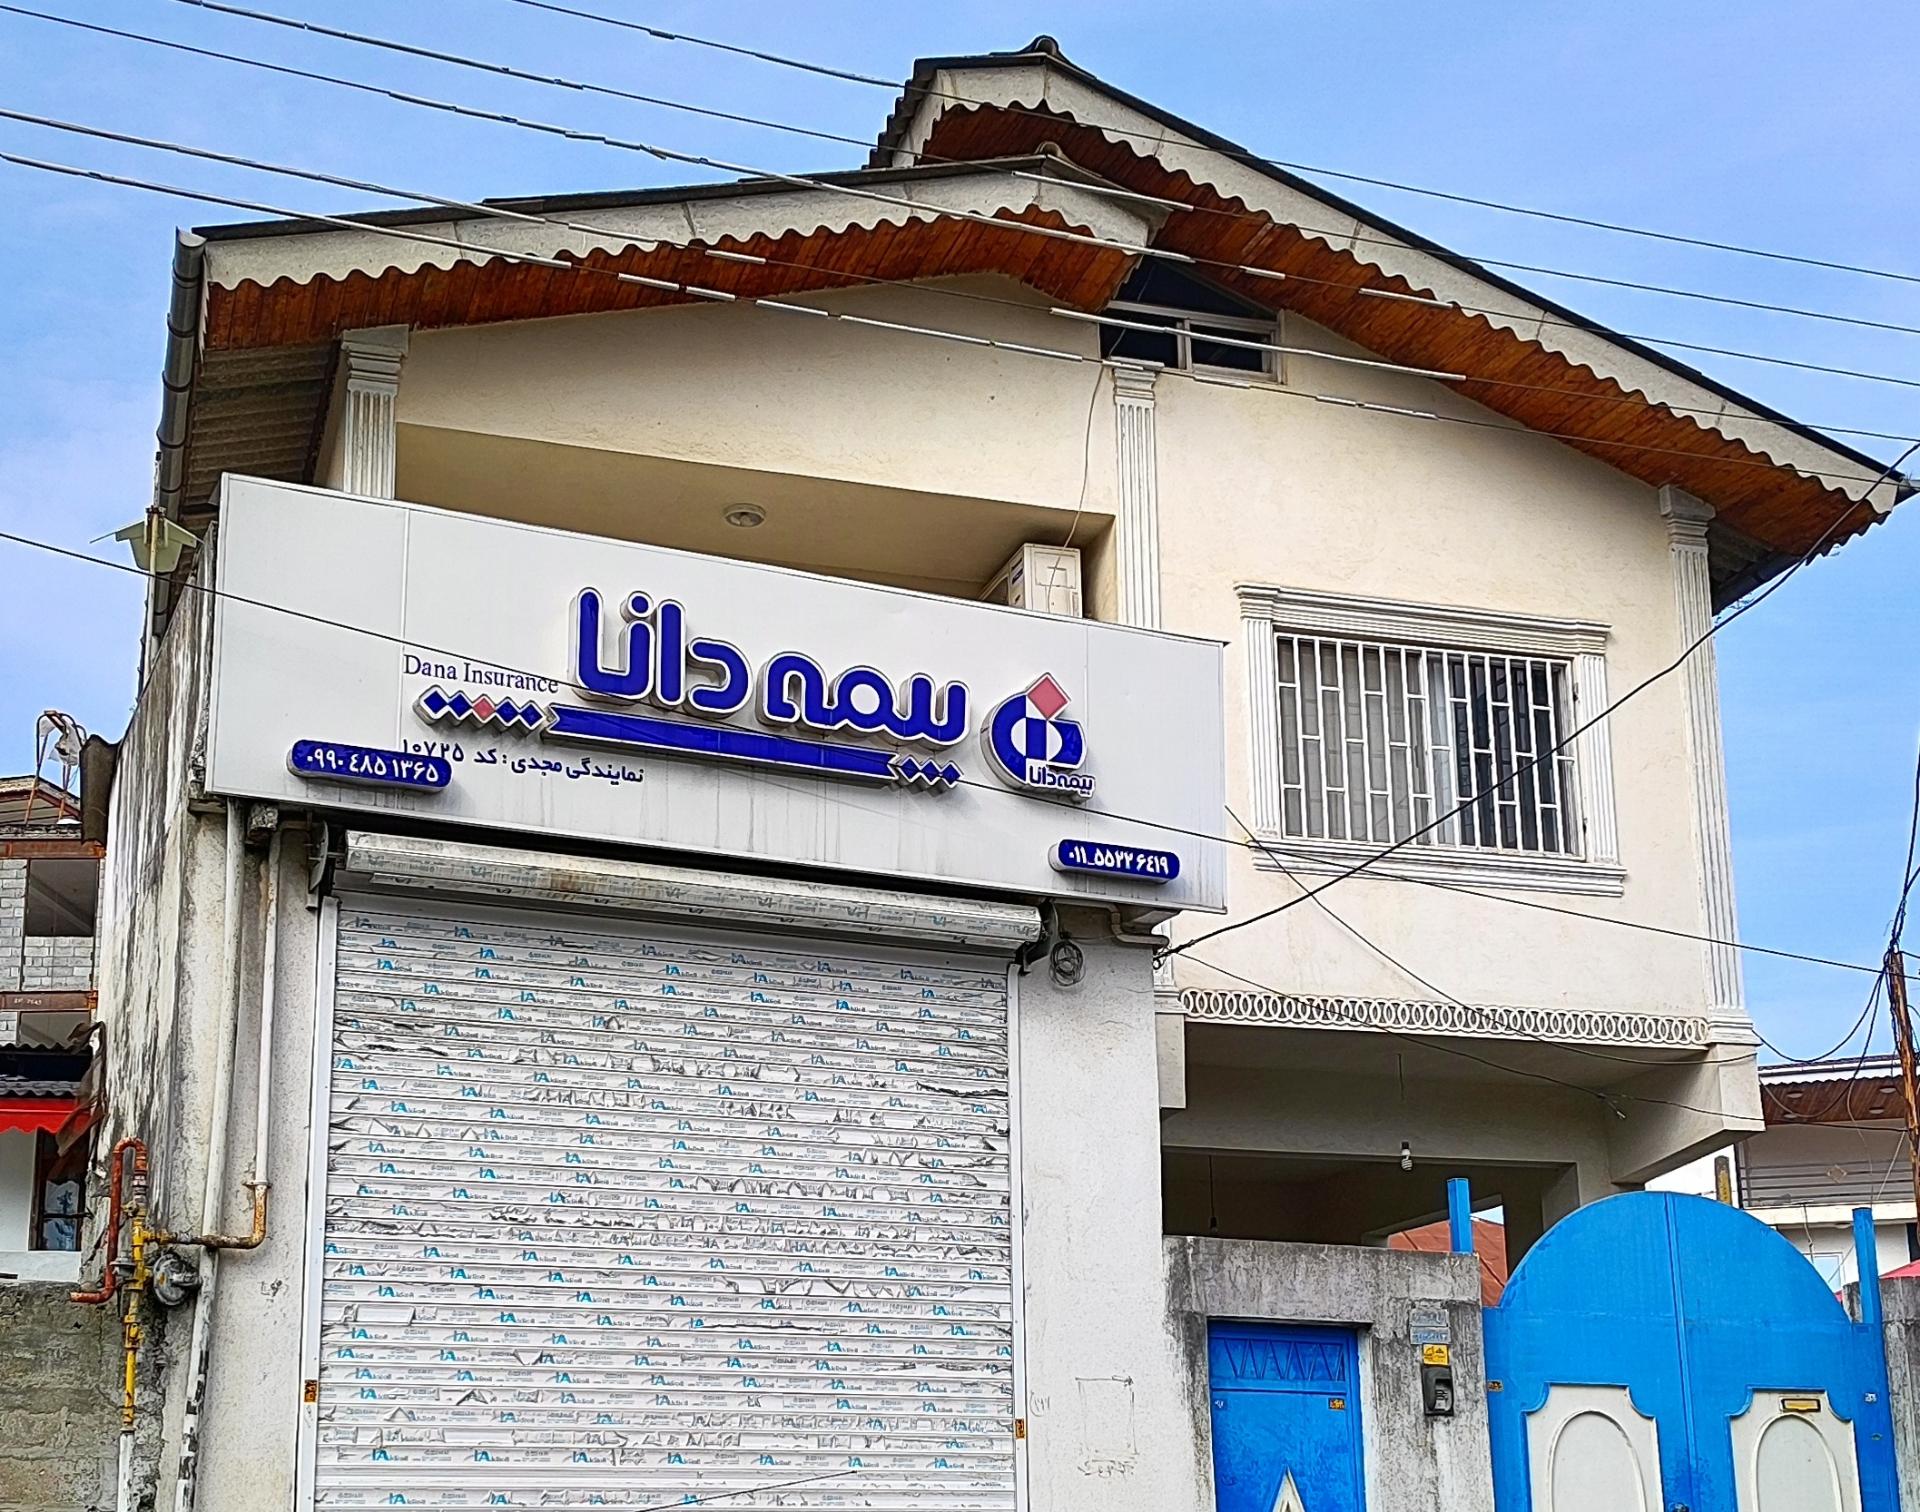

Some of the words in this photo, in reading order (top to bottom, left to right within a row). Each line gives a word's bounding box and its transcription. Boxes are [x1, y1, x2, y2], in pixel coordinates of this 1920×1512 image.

[577, 587, 752, 714] دانا
[403, 653, 458, 680] Dana
[463, 661, 560, 694] Insurance
[473, 748, 498, 765] کد
[565, 757, 645, 786] نمایندگی
[1028, 764, 1057, 786] دانا
